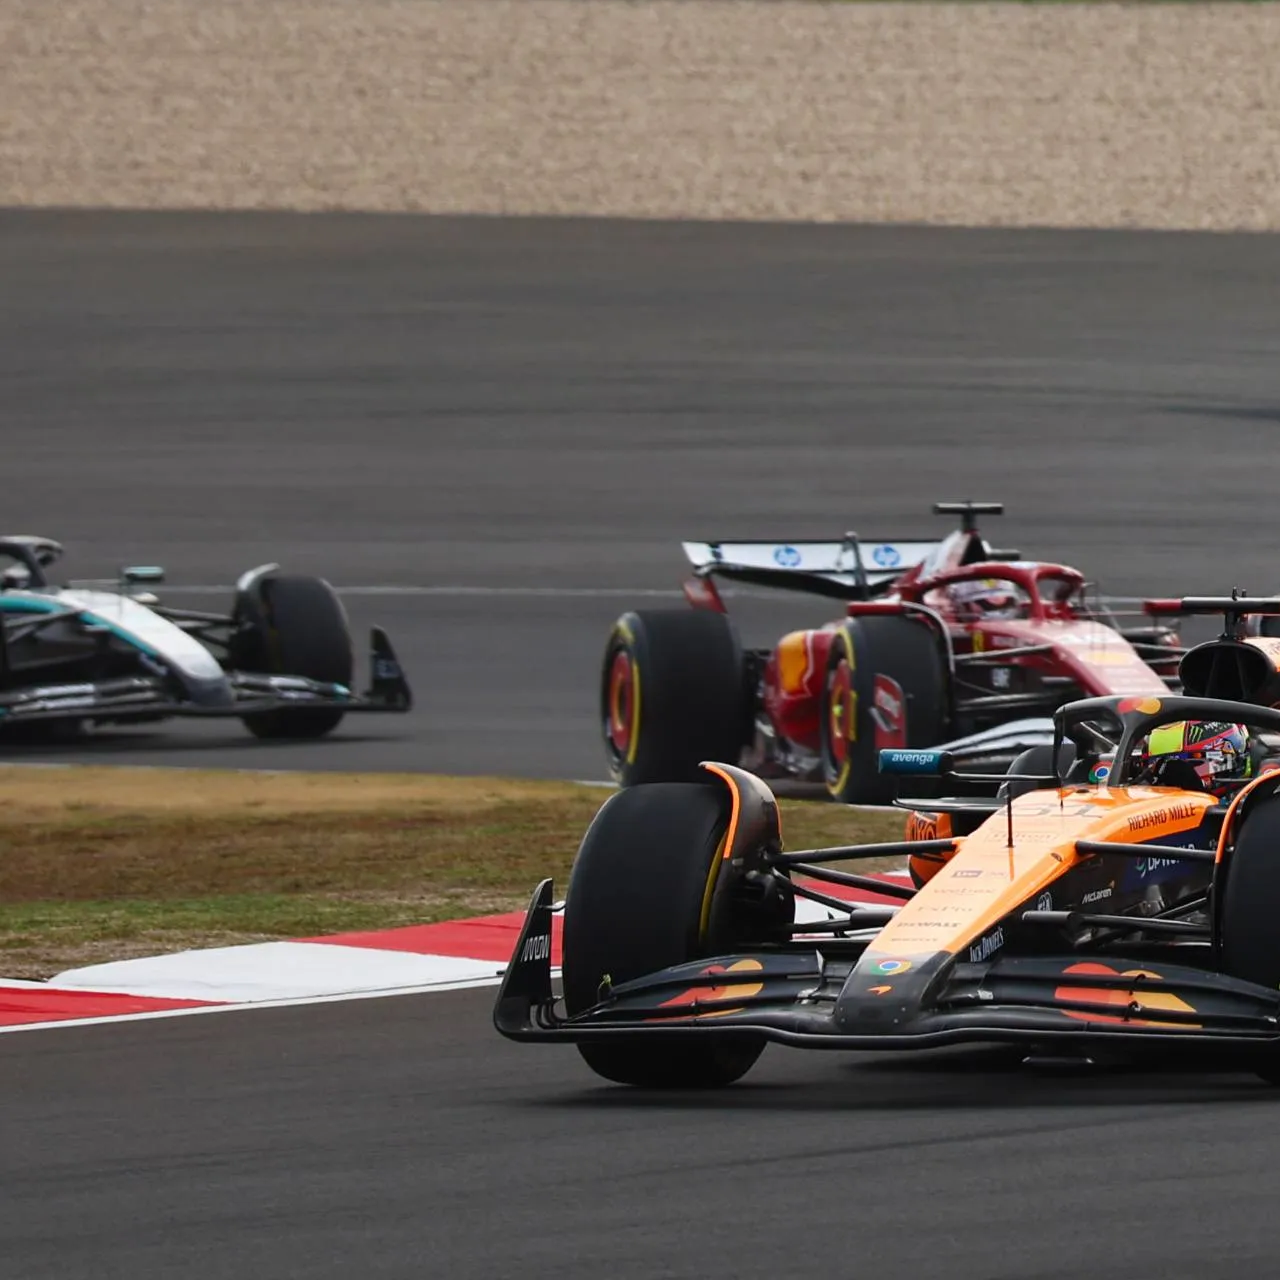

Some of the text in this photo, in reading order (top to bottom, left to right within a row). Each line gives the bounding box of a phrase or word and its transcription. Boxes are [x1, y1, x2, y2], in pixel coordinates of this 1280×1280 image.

[892, 753, 934, 765] avenga
[1168, 802, 1196, 822] MILLE
[1082, 888, 1112, 905] McLaren
